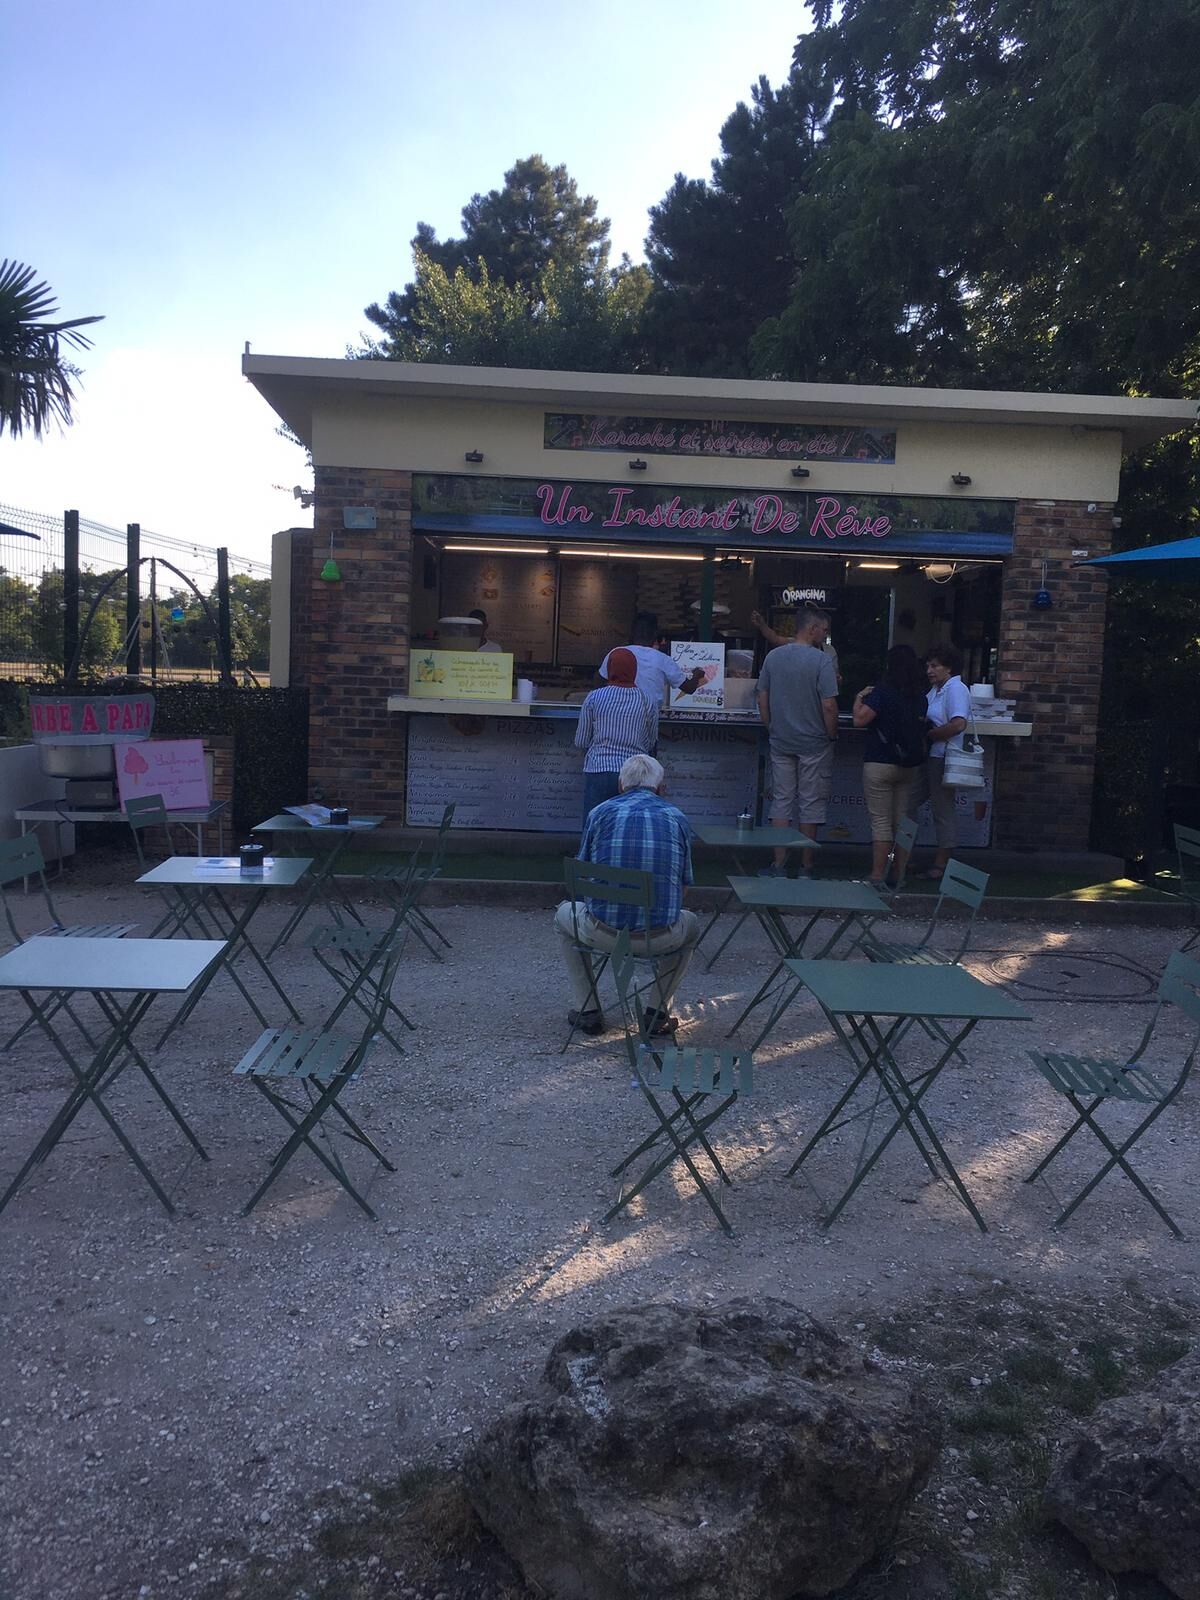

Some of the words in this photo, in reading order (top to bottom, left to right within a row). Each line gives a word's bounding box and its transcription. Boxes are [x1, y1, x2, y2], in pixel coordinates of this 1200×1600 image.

[588, 418, 676, 446] Karaoké
[679, 427, 701, 448] et
[704, 428, 773, 454] soirées
[777, 434, 802, 453] en
[806, 428, 838, 454] été
[536, 484, 593, 525] Un
[601, 488, 741, 531] Instant
[751, 494, 800, 536] De
[810, 496, 892, 539] Rêve
[782, 589, 826, 605] ORANGINA
[81, 704, 99, 732] A
[497, 721, 555, 736] PIZZAS
[671, 727, 737, 743] PANINIS
